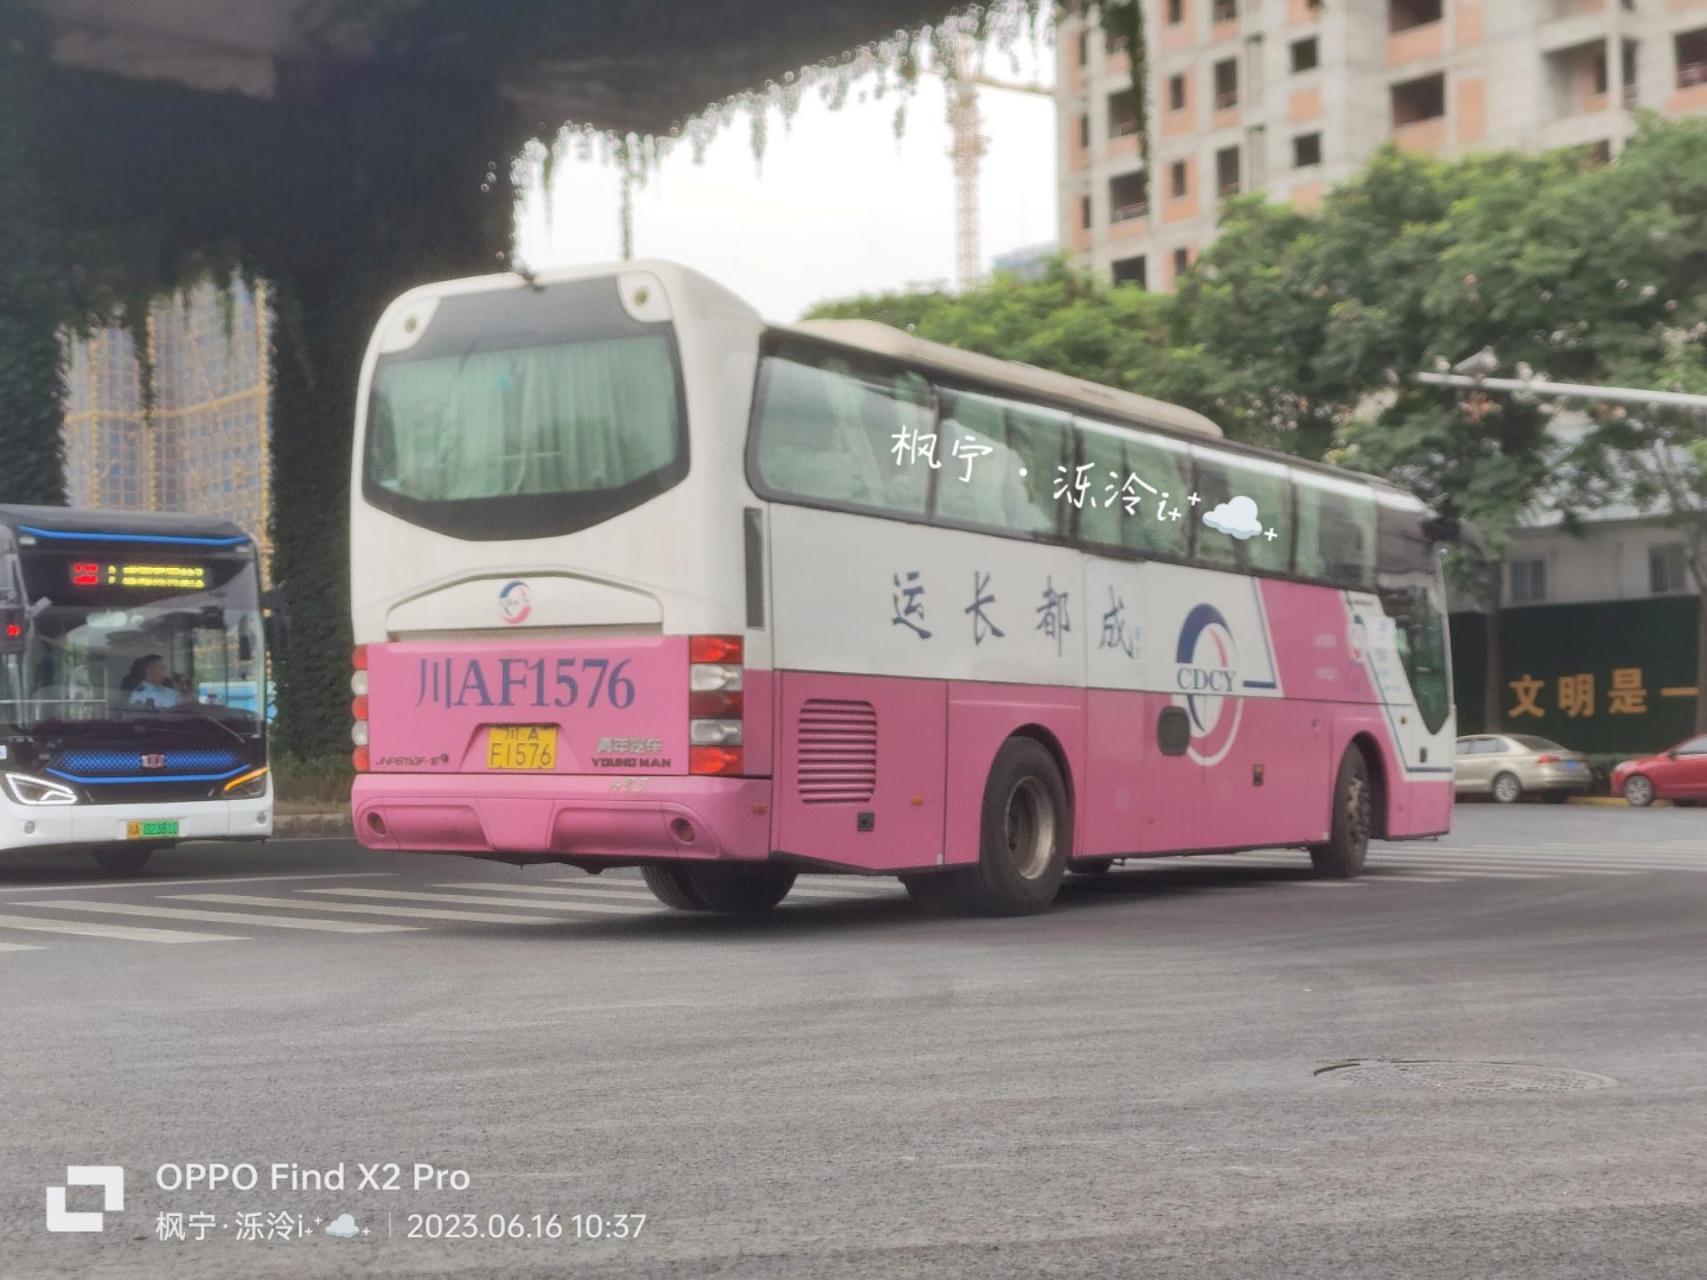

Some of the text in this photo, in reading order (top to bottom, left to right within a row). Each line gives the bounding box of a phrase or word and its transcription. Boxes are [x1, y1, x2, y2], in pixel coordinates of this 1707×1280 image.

[416, 657, 636, 709] 川AF1576
[1177, 667, 1236, 692] CDCY
[1508, 667, 1699, 718] 文明是一
[490, 743, 552, 766] F1576
[591, 758, 672, 768] YOUNG MAN
